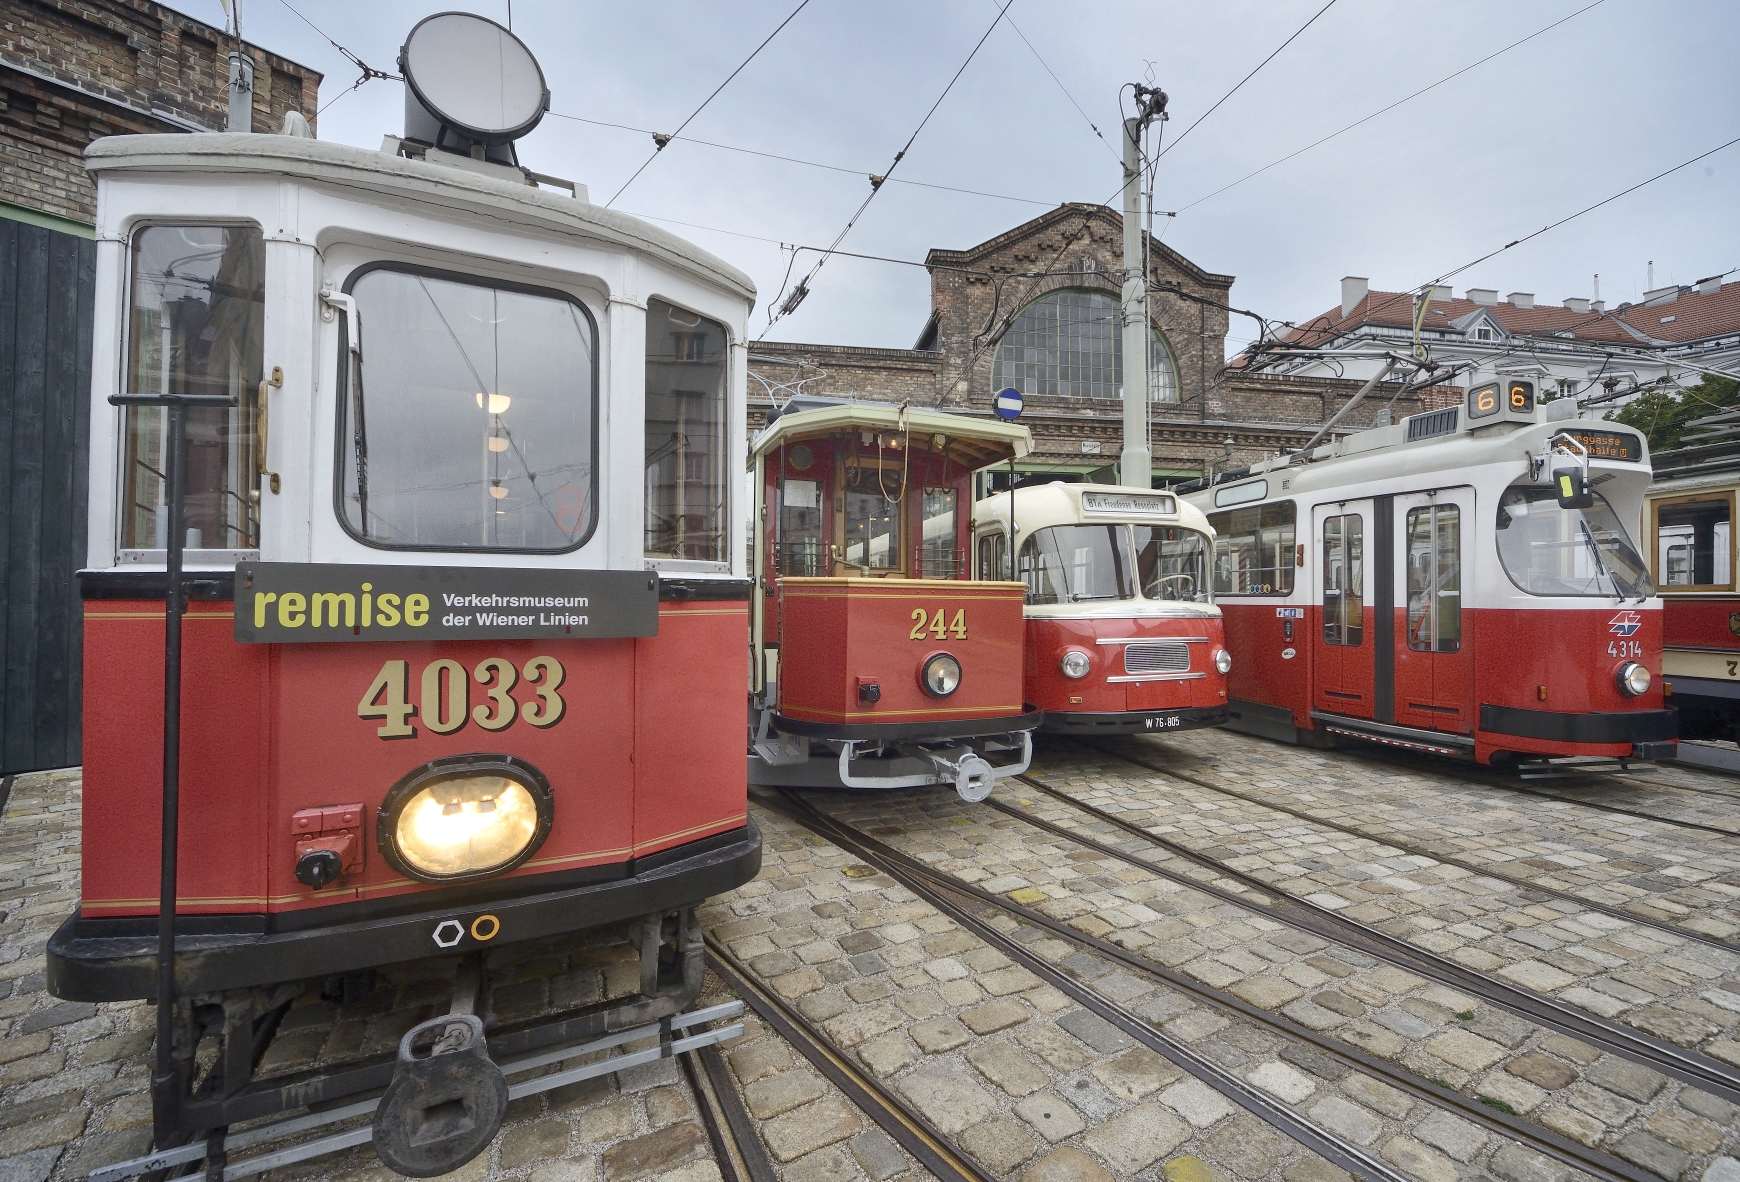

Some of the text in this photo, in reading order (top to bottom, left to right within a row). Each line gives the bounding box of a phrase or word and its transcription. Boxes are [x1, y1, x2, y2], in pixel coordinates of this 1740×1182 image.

[1477, 389, 1495, 411] 6
[1511, 386, 1525, 407] 6
[253, 582, 430, 628] remise
[442, 593, 589, 608] Verkehrsmuseum
[442, 612, 589, 627] der Wiener Linien
[909, 607, 968, 641] 244
[357, 655, 567, 741] 4033
[1145, 718, 1153, 729] W
